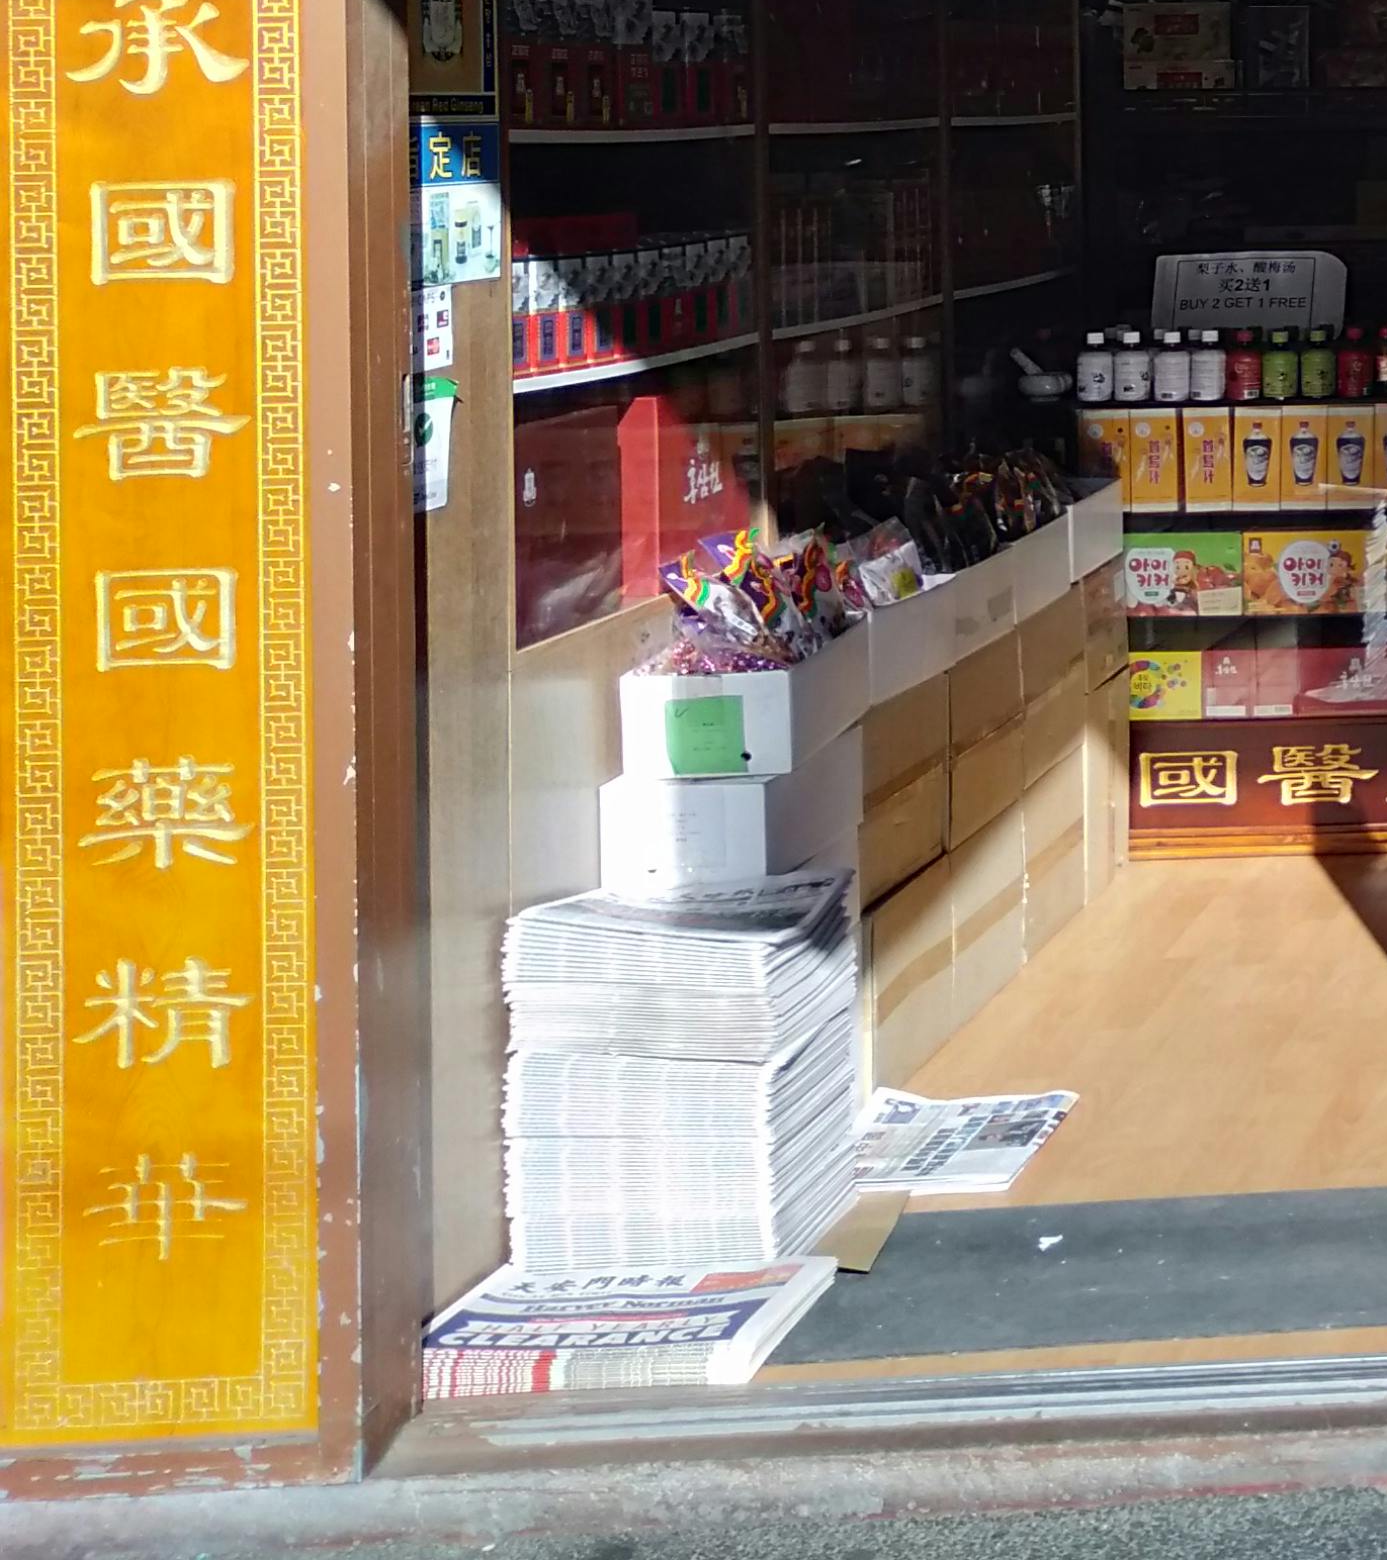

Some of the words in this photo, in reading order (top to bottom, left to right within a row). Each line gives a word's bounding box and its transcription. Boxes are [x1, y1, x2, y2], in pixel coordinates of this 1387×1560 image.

[1218, 278, 1271, 293] 买2送1
[1179, 298, 1208, 310] BUY
[1212, 297, 1220, 309] 2
[1224, 297, 1253, 309] GET
[1269, 296, 1308, 308] FREE
[1128, 557, 1168, 573] 아이
[1283, 556, 1323, 572] 아이
[1136, 573, 1170, 587] 키커
[1291, 572, 1324, 587] 키커
[438, 1323, 734, 1349] CLEARANCE
